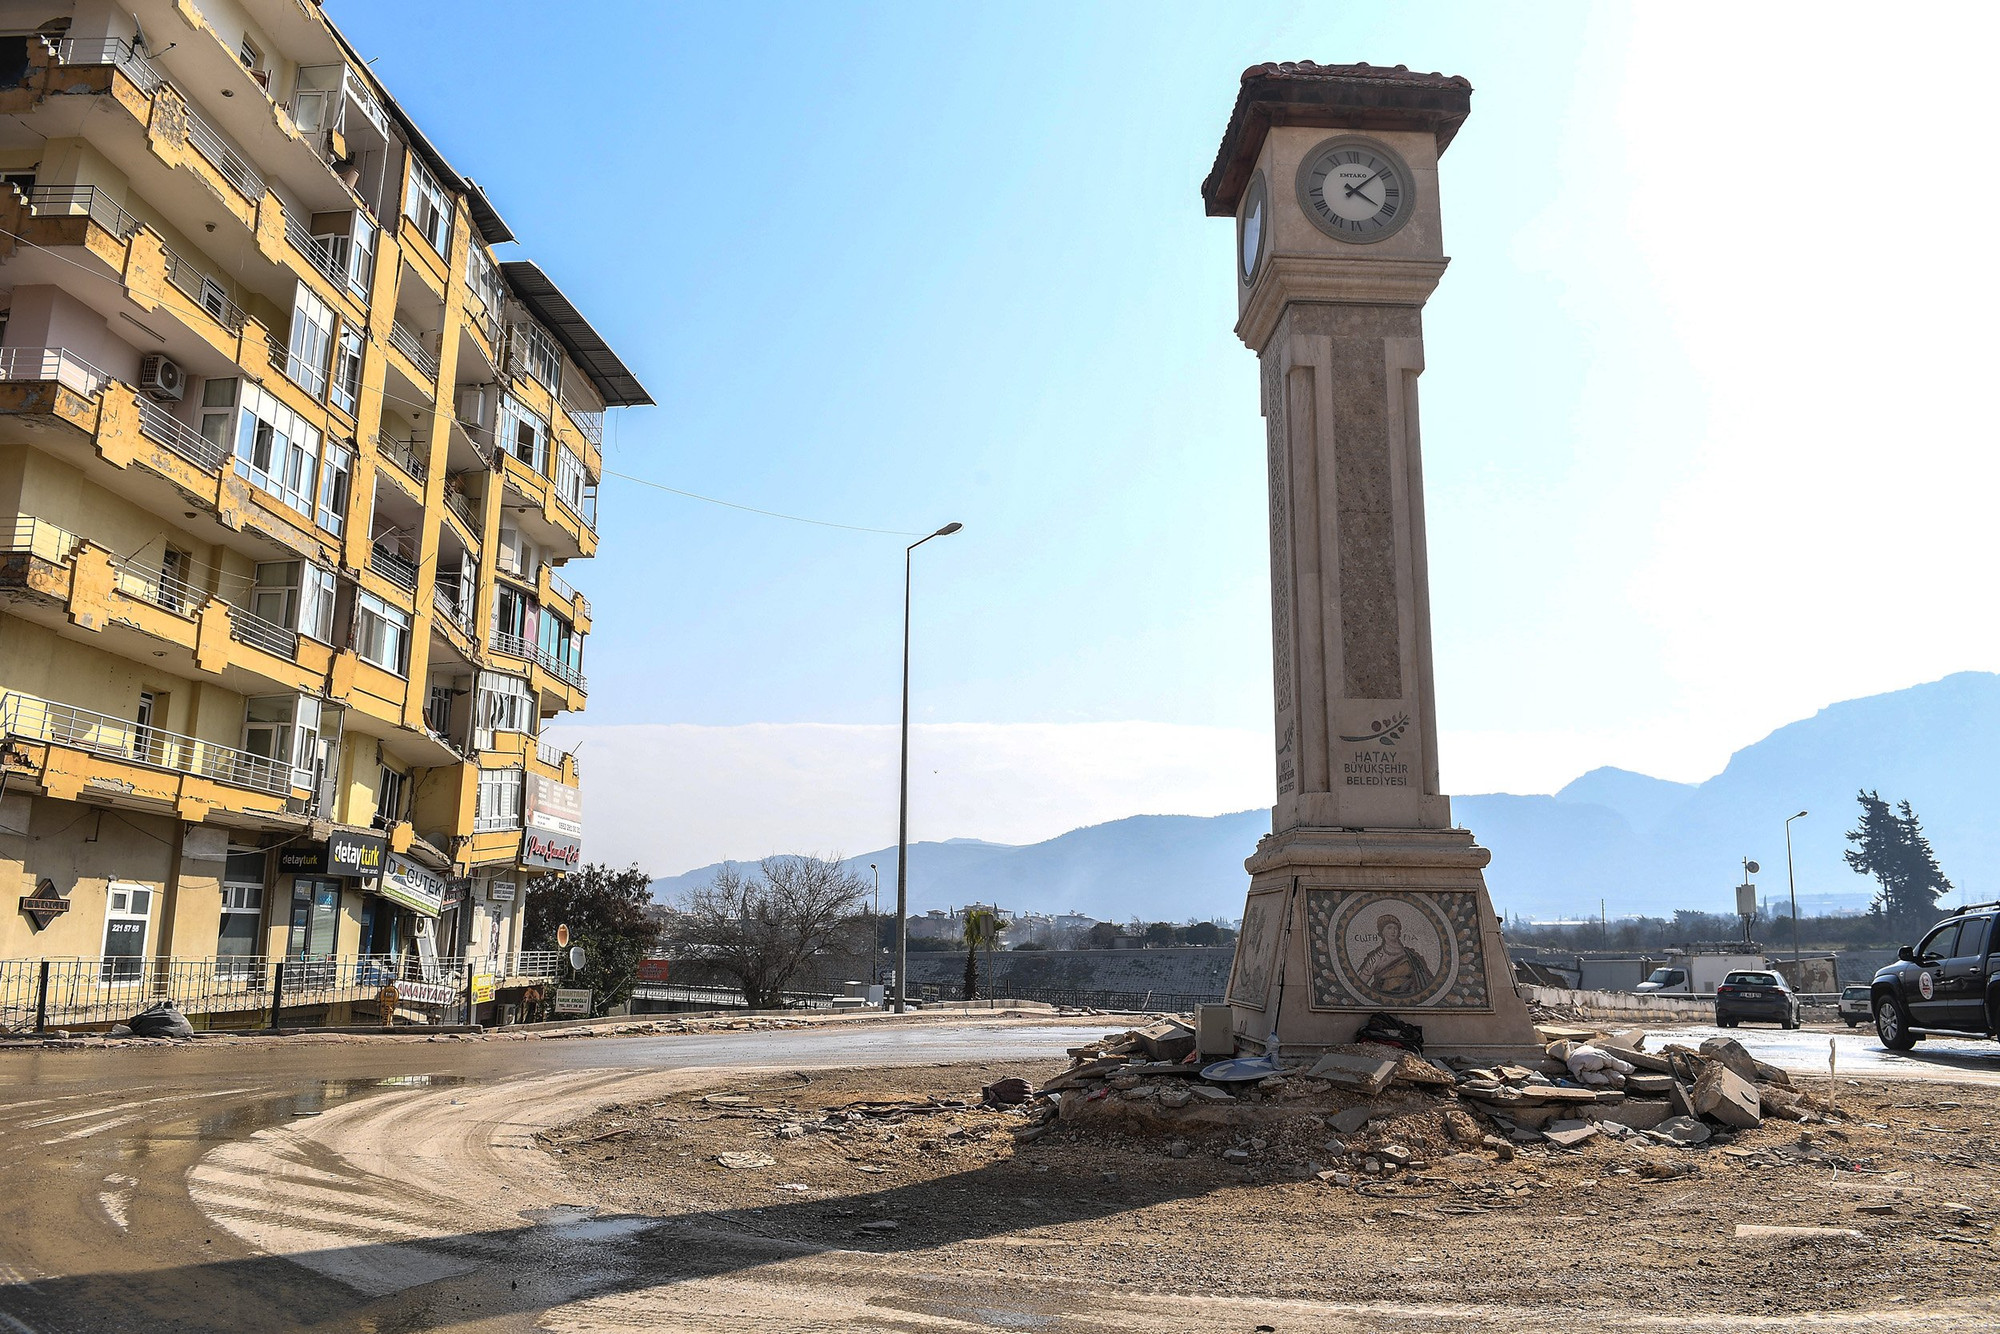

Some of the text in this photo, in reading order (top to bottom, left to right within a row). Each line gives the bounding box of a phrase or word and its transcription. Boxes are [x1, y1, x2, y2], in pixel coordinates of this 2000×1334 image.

[1355, 751, 1397, 762] HATAY
[1344, 761, 1408, 774] BÜYÜKŞEHİR
[1346, 774, 1407, 785] BELEDİYESİ
